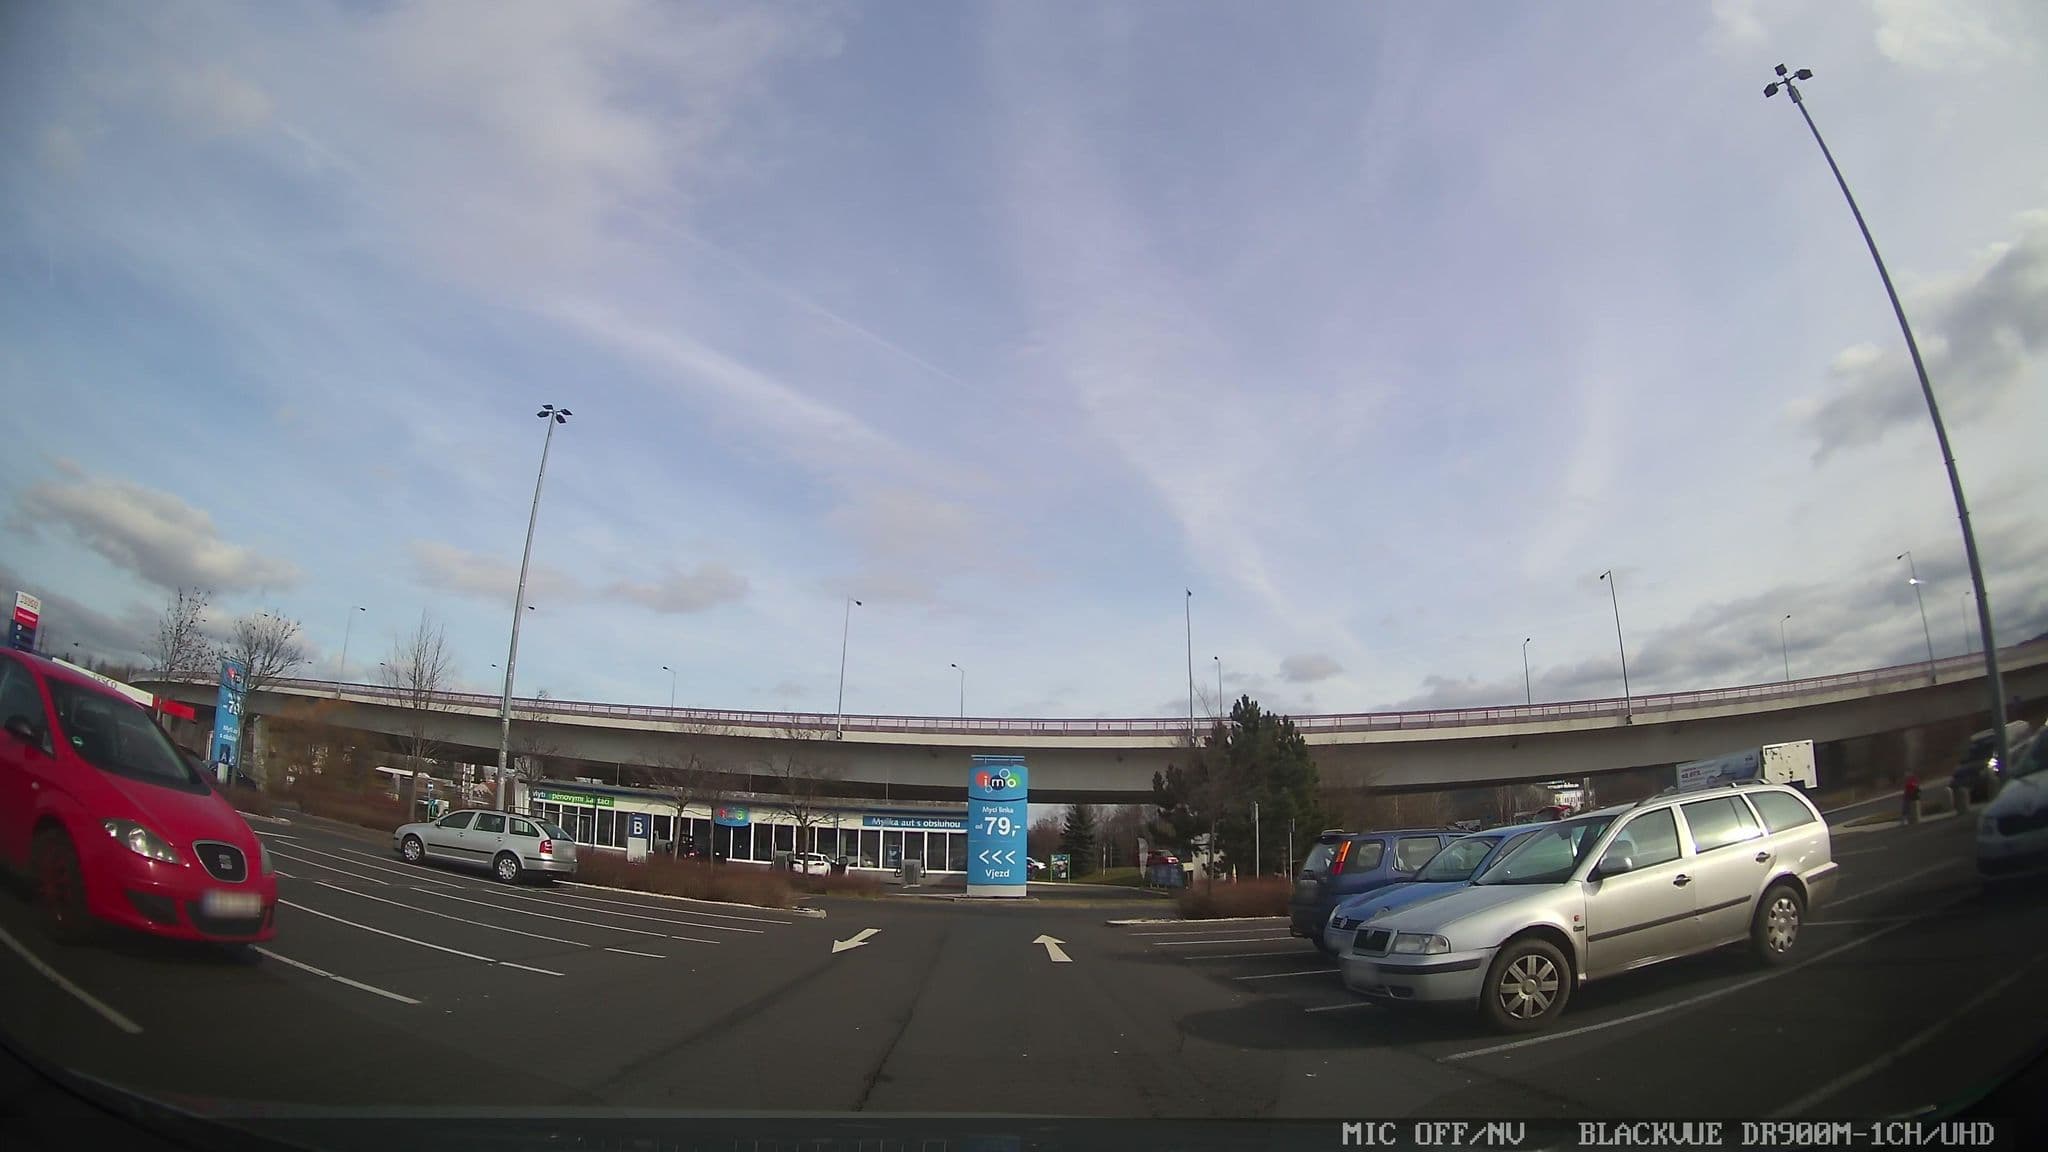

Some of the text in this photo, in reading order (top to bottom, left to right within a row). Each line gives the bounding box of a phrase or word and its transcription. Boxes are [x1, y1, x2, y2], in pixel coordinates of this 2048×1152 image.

[983, 774, 1017, 788] imo
[633, 820, 643, 835] B
[985, 868, 1010, 880] Vjezd
